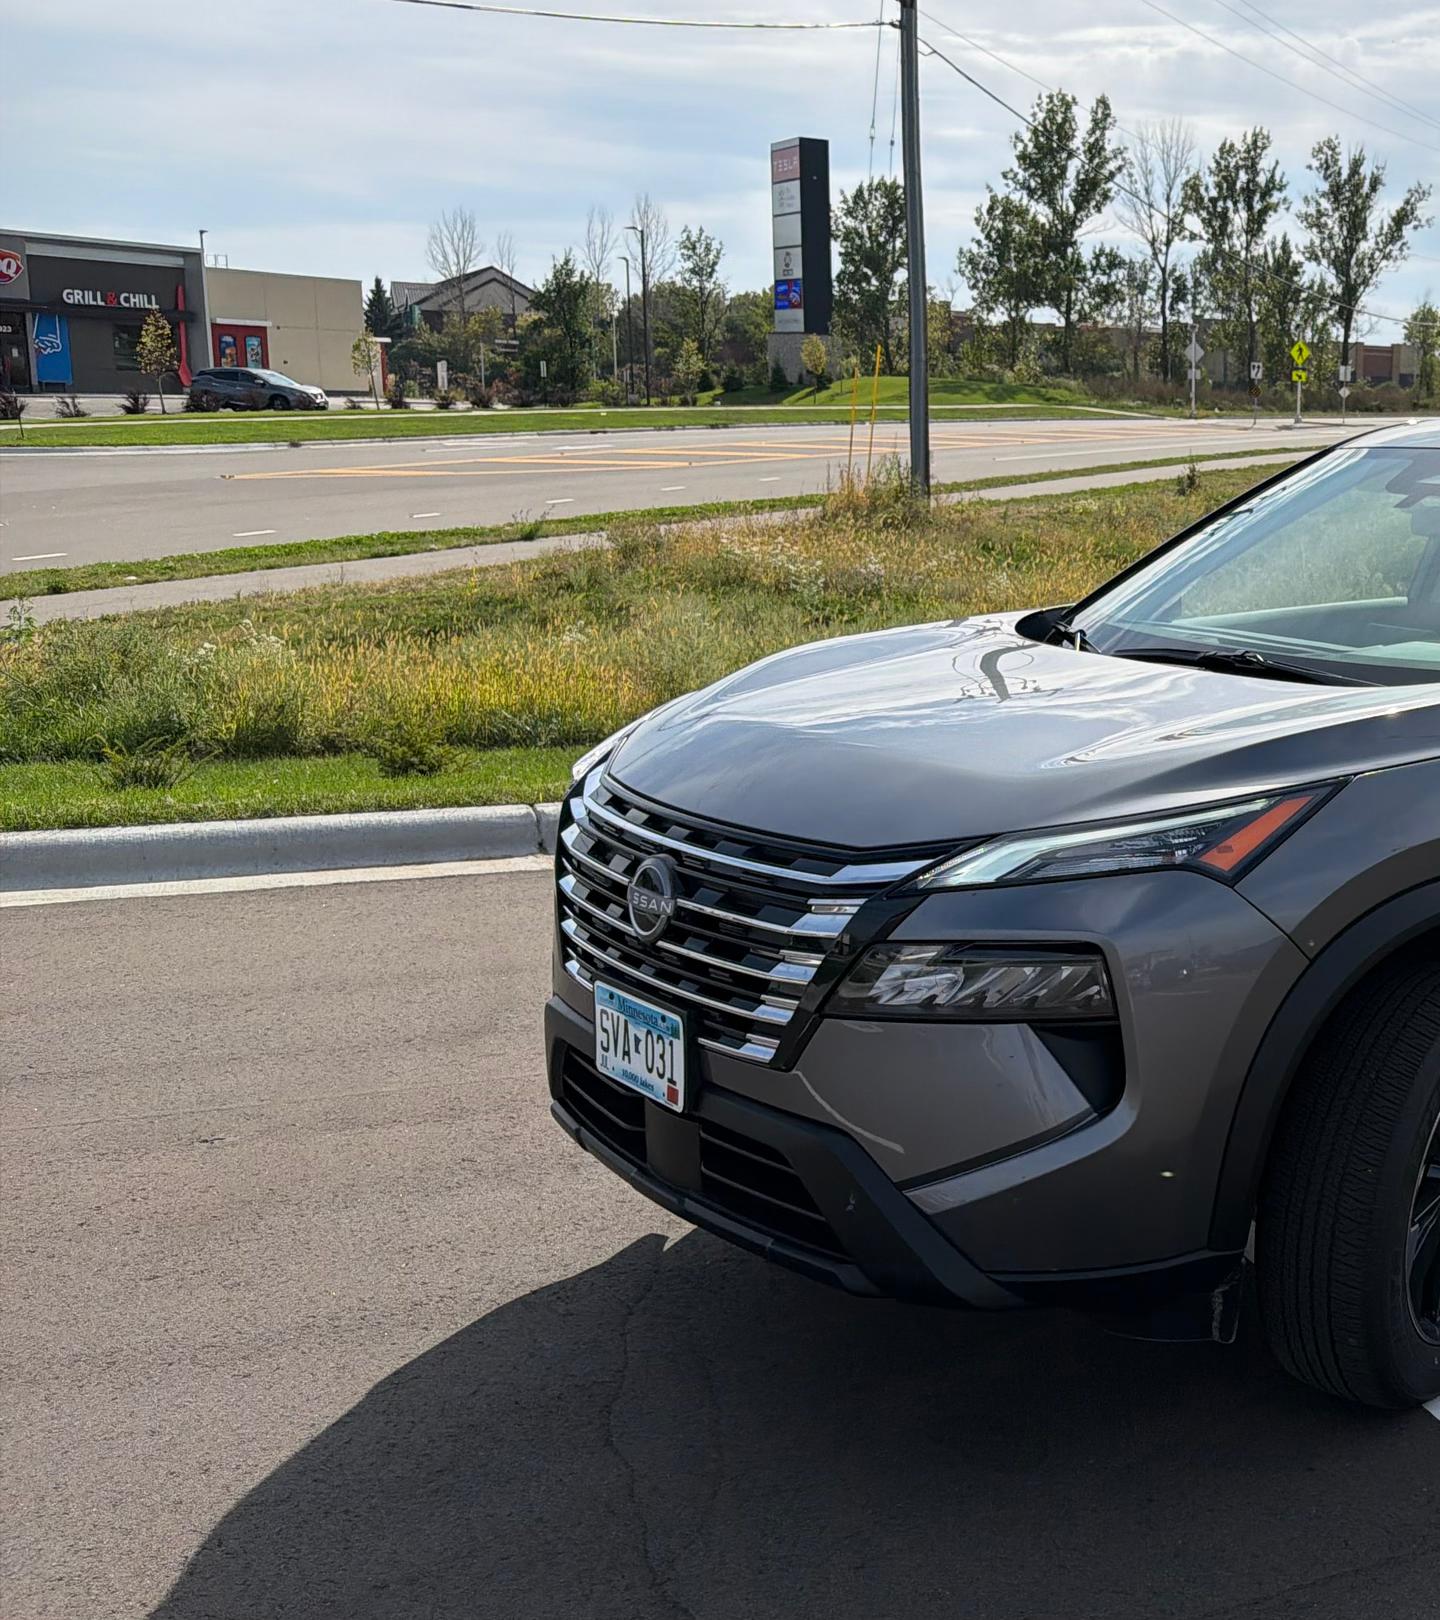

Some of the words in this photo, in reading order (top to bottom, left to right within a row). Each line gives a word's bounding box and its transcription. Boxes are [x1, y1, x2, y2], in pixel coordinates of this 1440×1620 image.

[0, 258, 16, 277] Q
[62, 288, 105, 306] GRILL
[106, 291, 117, 306] &
[119, 292, 160, 308] CHILL
[632, 891, 672, 914] SSAN
[617, 995, 659, 1026] Minnesota
